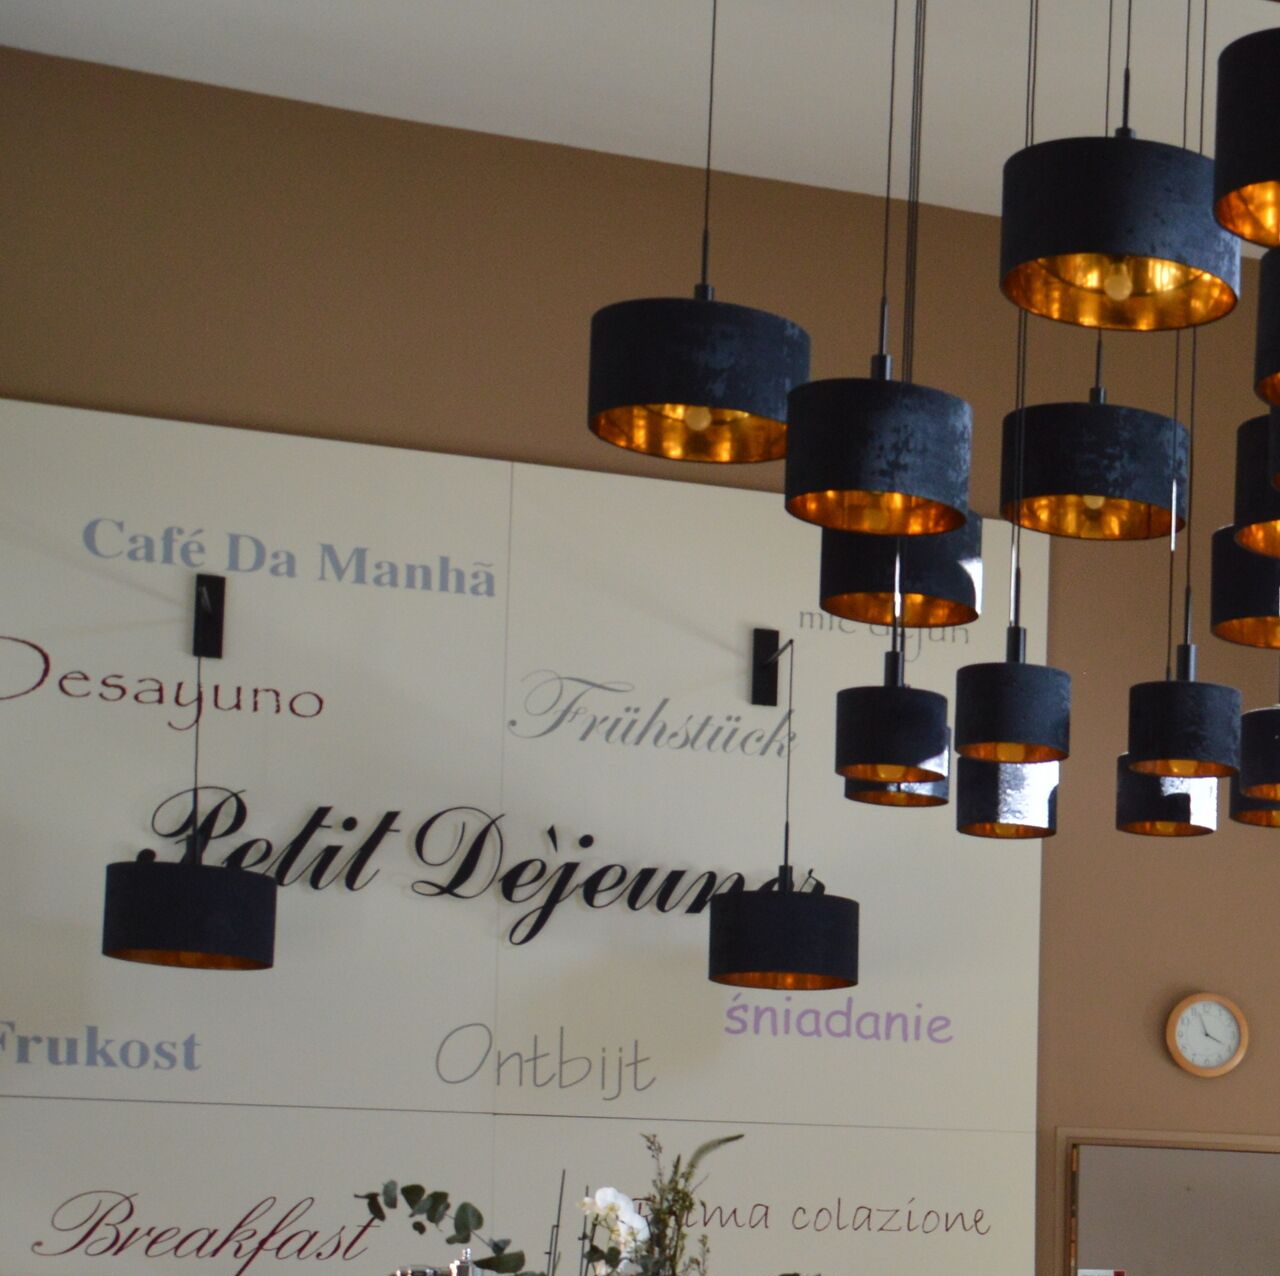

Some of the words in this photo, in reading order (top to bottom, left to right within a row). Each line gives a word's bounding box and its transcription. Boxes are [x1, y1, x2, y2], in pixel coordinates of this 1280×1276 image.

[82, 517, 206, 568] Café
[226, 532, 297, 578] Da
[319, 542, 497, 598] Manhã
[0, 635, 325, 731] Desayuno
[507, 669, 798, 759] Frühstück
[136, 786, 402, 891] Petit
[723, 992, 955, 1045] śniadanie
[435, 1022, 657, 1101] Ontbijt
[790, 1197, 993, 1237] colazione
